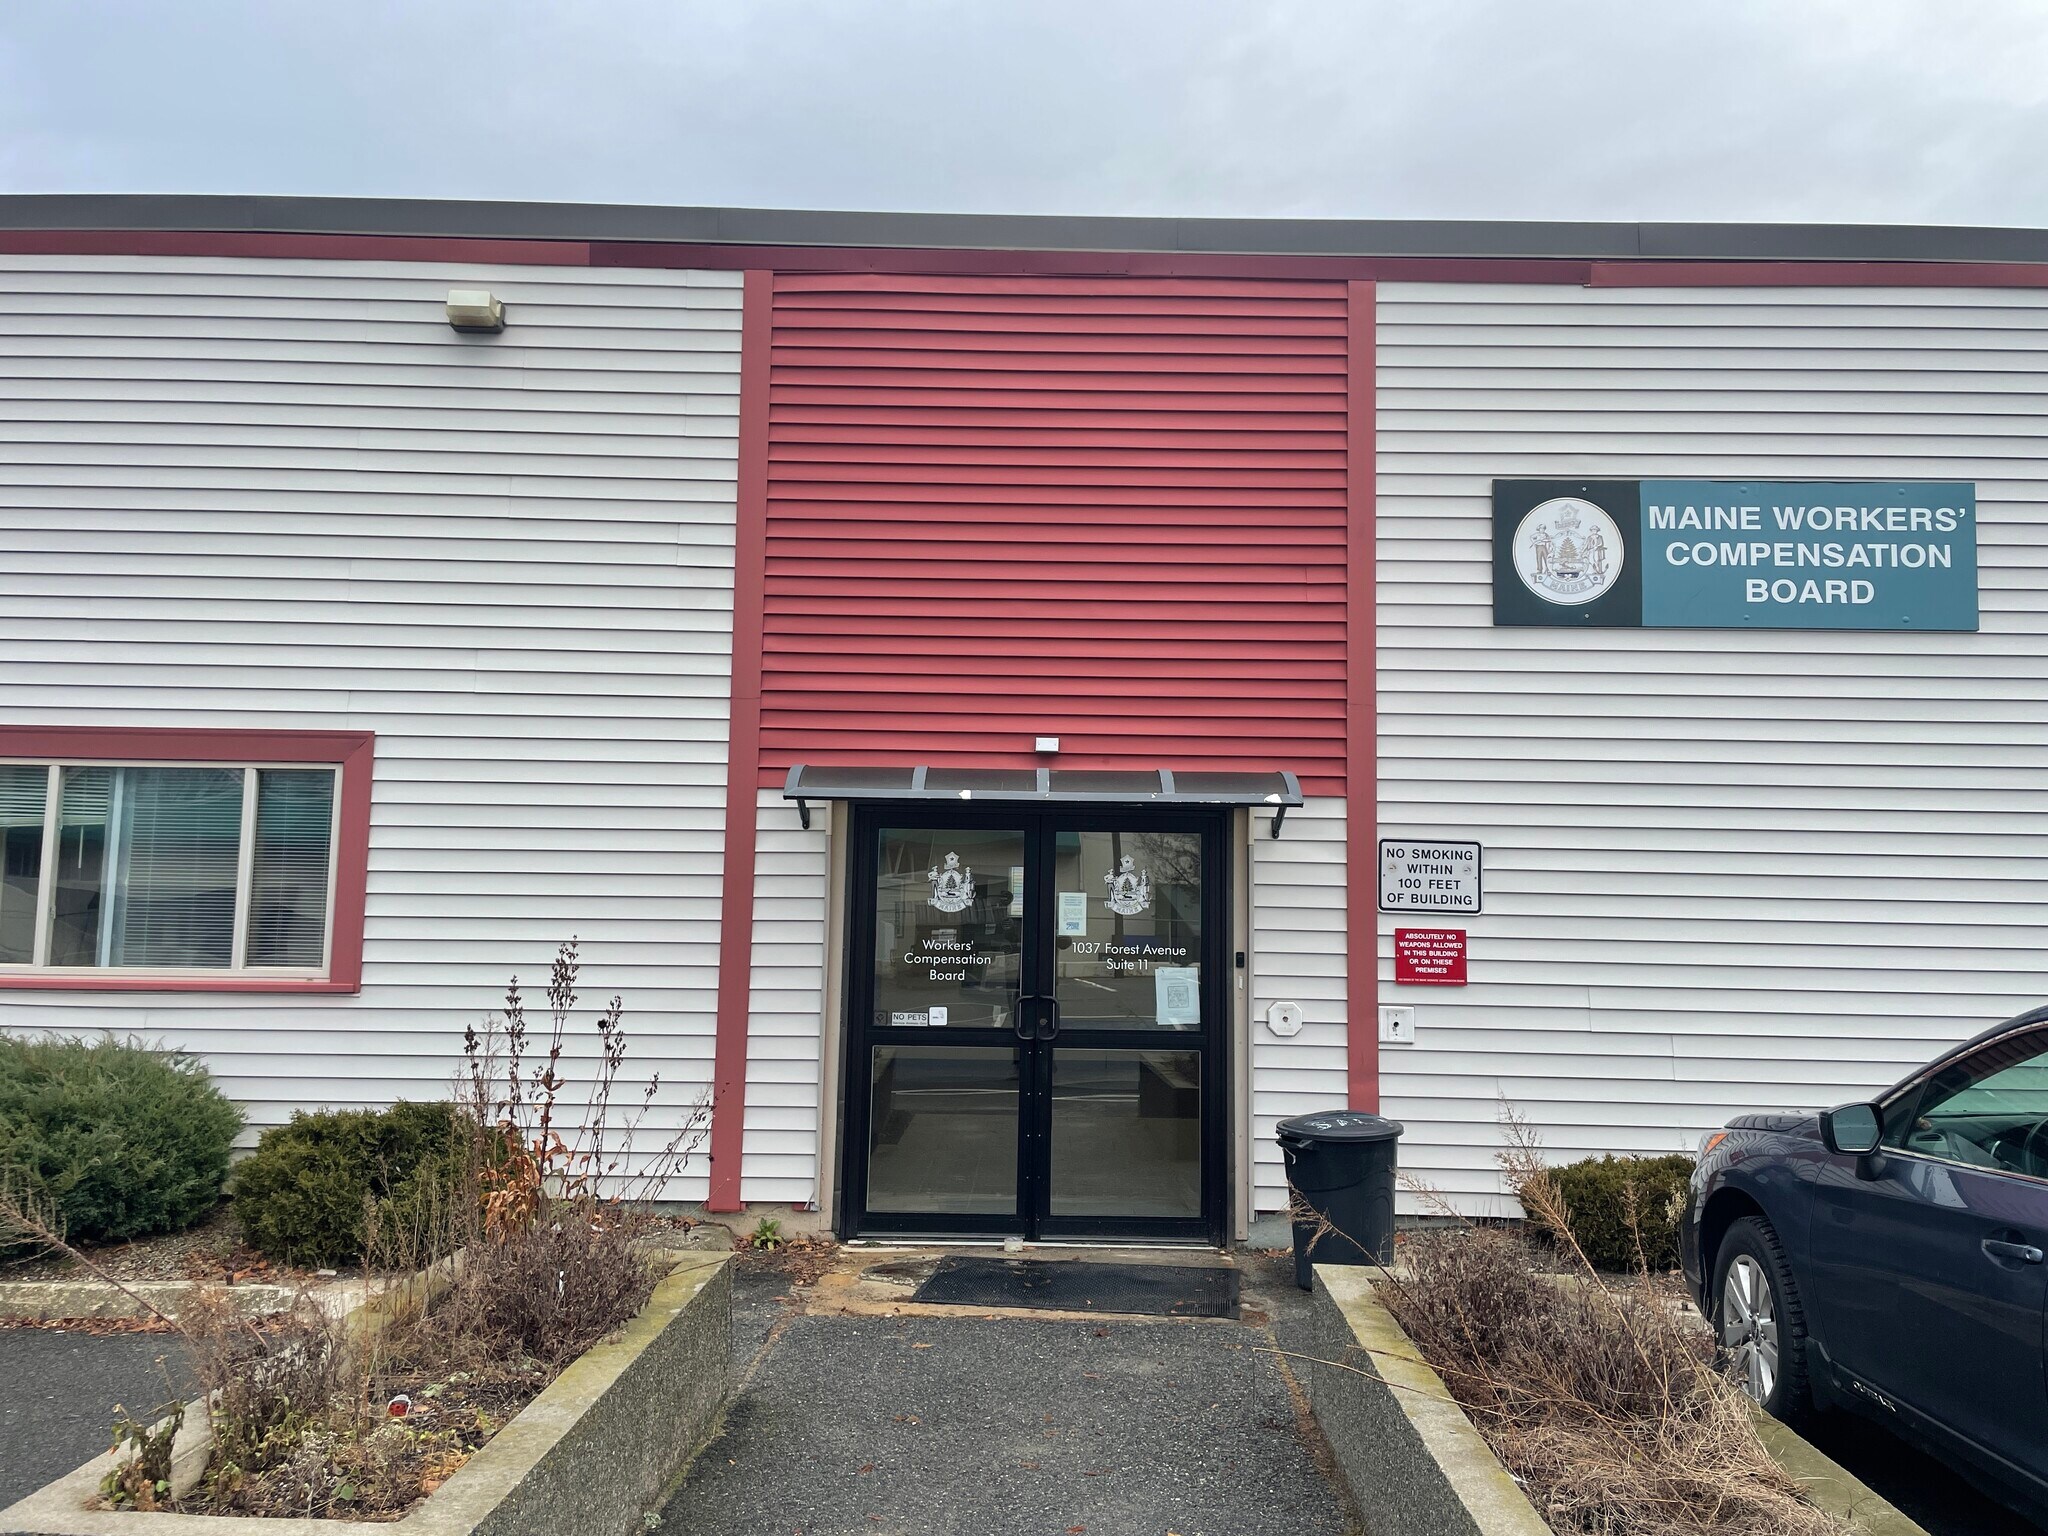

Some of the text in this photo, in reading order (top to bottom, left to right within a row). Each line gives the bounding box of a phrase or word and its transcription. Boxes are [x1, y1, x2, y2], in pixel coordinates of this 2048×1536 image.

[1649, 506, 1966, 532] MAINE WORKERS’
[1666, 542, 1951, 568] COMPENSATION
[1549, 581, 1588, 592] MAINE
[1746, 579, 1875, 604] BOARD
[1386, 848, 1473, 861] NO SMOKING
[1407, 864, 1453, 875] WITHIN
[1398, 878, 1461, 890] 100 FEET
[1387, 893, 1472, 905] OF BUILDING
[922, 939, 974, 951] Workers'
[1072, 942, 1186, 956] 1037 Forest Avenue
[904, 953, 991, 967] Compensation
[1106, 958, 1148, 970] Suite 11
[929, 969, 965, 981] Board
[907, 1013, 927, 1021] PETS
